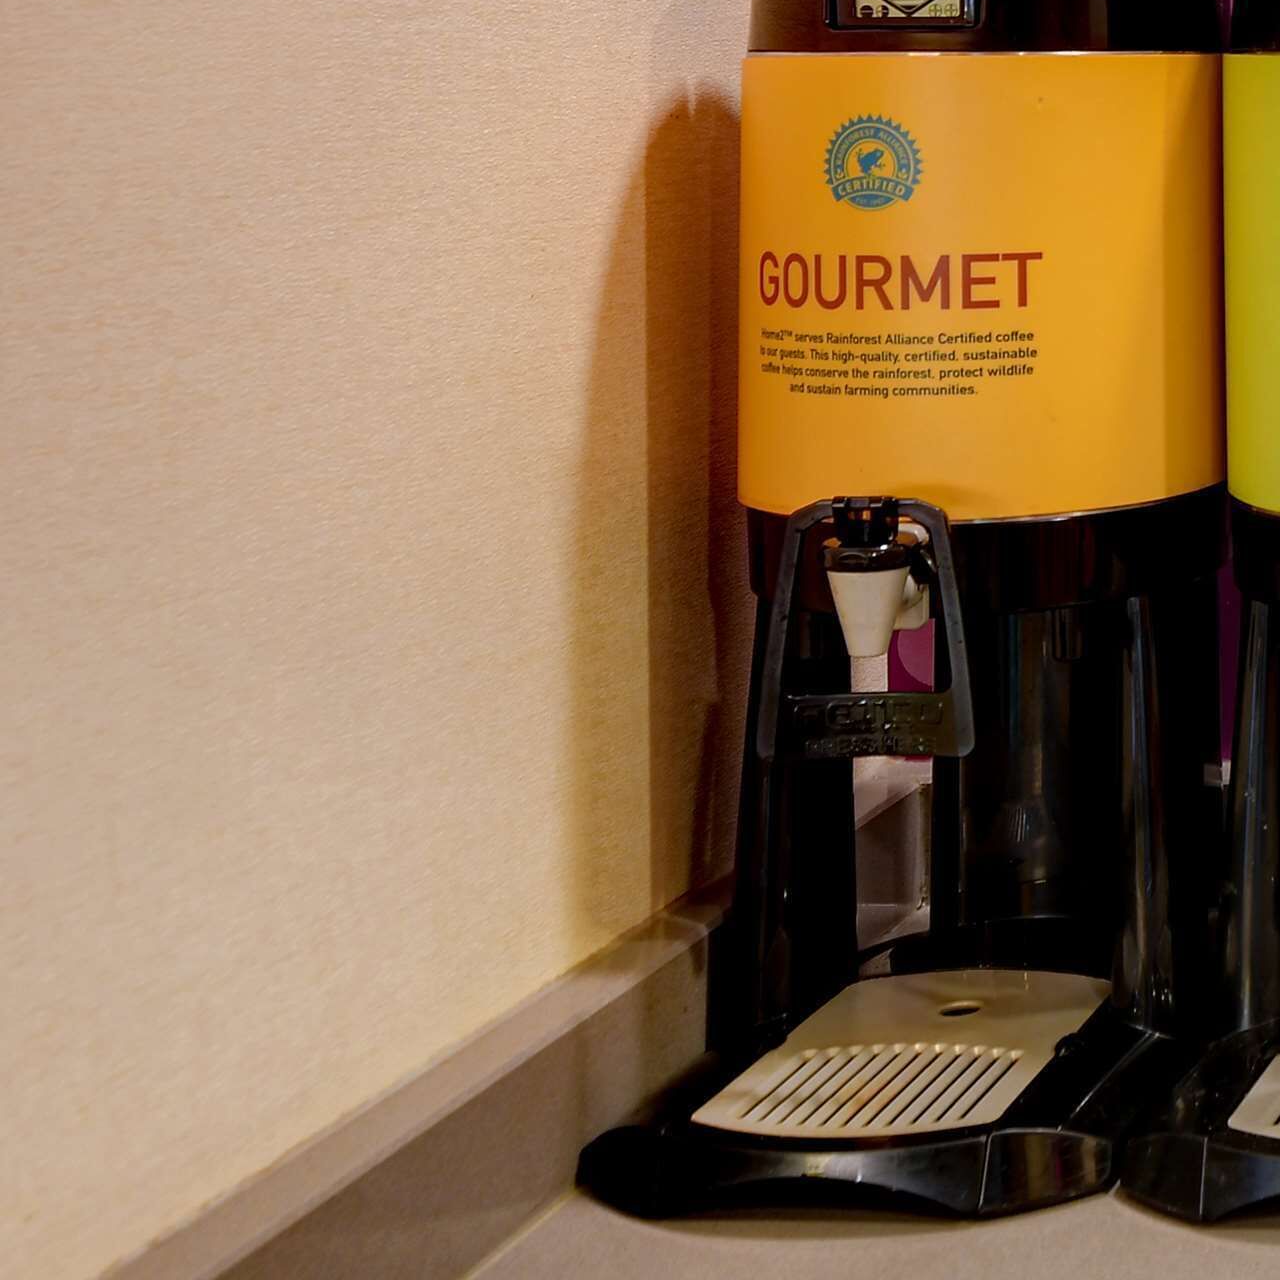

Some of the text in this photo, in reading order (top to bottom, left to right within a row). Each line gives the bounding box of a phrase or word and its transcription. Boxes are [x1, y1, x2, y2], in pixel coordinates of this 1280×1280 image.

[838, 178, 906, 196] CERTIFIED
[759, 251, 1043, 310] GOURMET
[795, 333, 823, 343] serves
[826, 332, 881, 345] Rainforest
[884, 333, 934, 345] Alliance
[938, 332, 992, 344] Certified
[995, 330, 1035, 343] coffee
[766, 347, 778, 357] our
[810, 349, 829, 361] This
[831, 350, 901, 365] high-quality,
[963, 348, 1038, 361] sustainable
[782, 365, 803, 378] helps
[804, 367, 849, 378] conserve
[851, 368, 870, 379] the
[939, 367, 984, 381] protect
[987, 364, 1034, 377] wildlife
[789, 383, 978, 399] and sustain farming communities.
